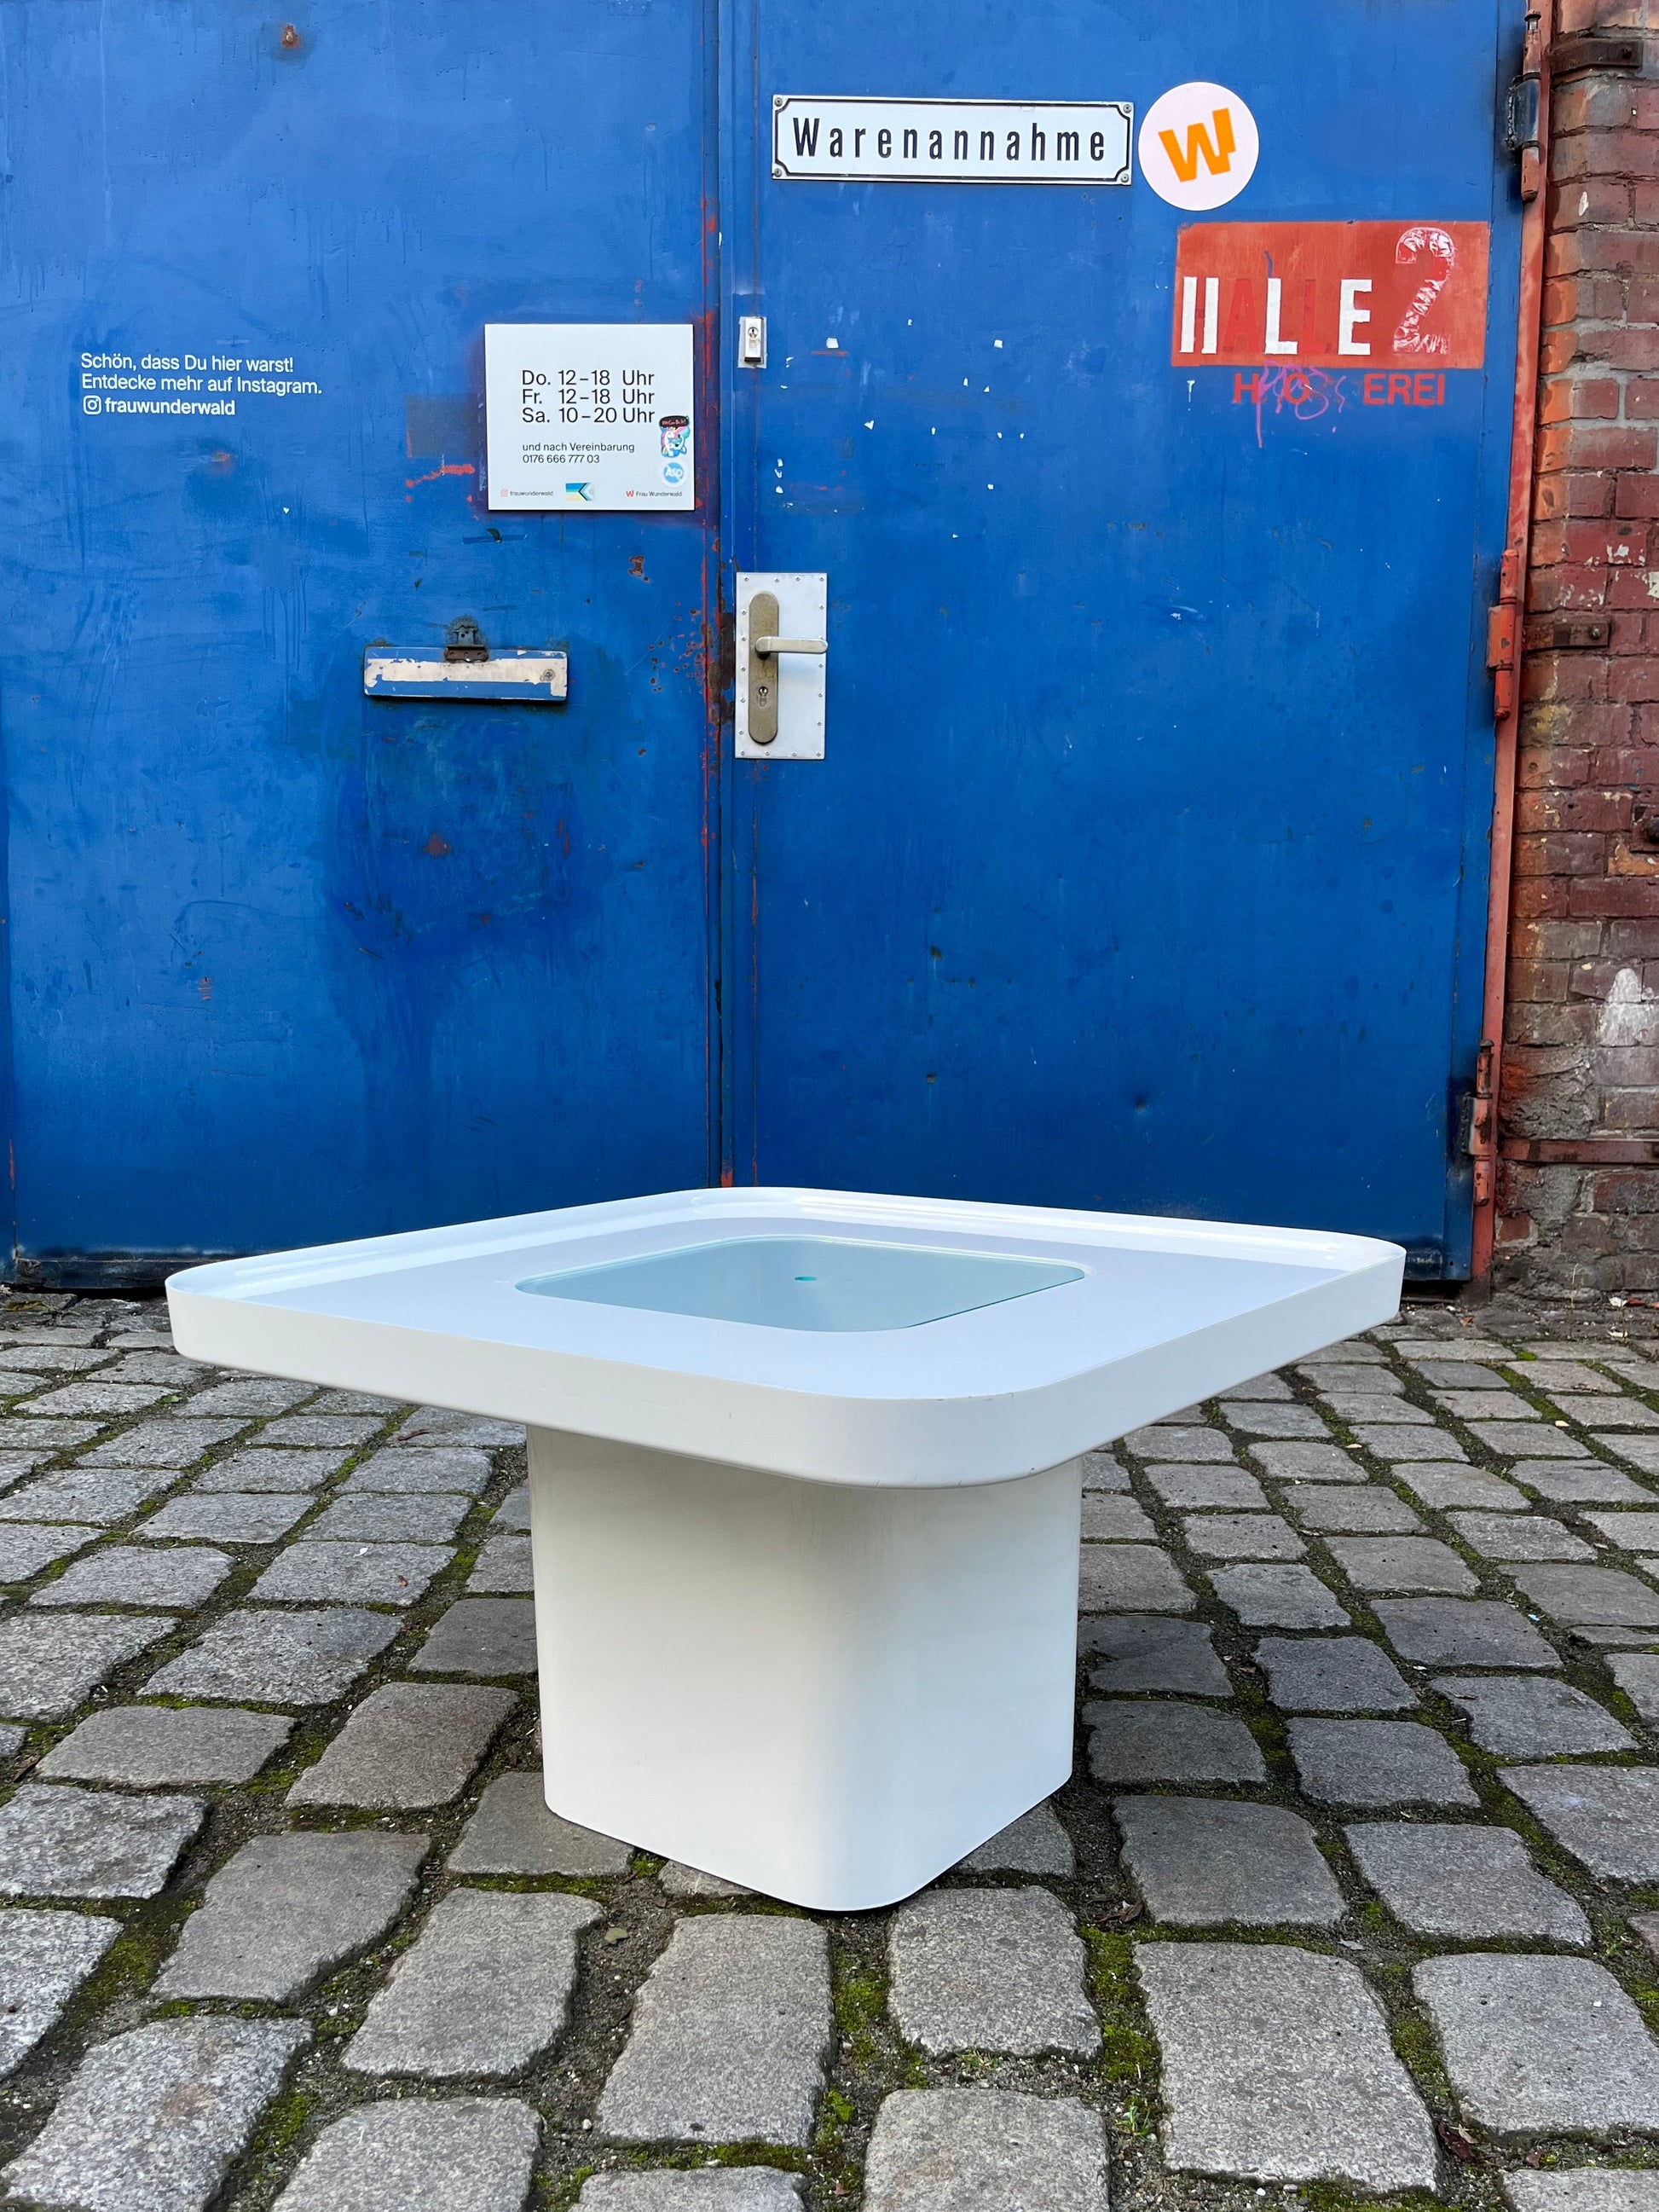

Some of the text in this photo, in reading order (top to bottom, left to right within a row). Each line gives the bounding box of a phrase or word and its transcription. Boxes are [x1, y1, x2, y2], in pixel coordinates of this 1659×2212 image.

[793, 118, 1105, 162] Warenannahme
[1158, 107, 1235, 182] W
[1393, 227, 1454, 355] 2
[81, 353, 293, 373] Schön, dass Du hier warst!
[82, 373, 322, 397] Entdecke mehr auf Instagram.
[522, 369, 552, 385] Do.
[622, 369, 655, 385] Uhr
[522, 388, 543, 404] Fr.
[622, 388, 656, 404] Uhr
[105, 397, 235, 415] frauwunderwald
[522, 407, 551, 423] Sa.
[622, 407, 656, 423] Uhr
[522, 442, 635, 454] und nach Vereinbarung
[522, 454, 600, 464] 0176 666 777 03
